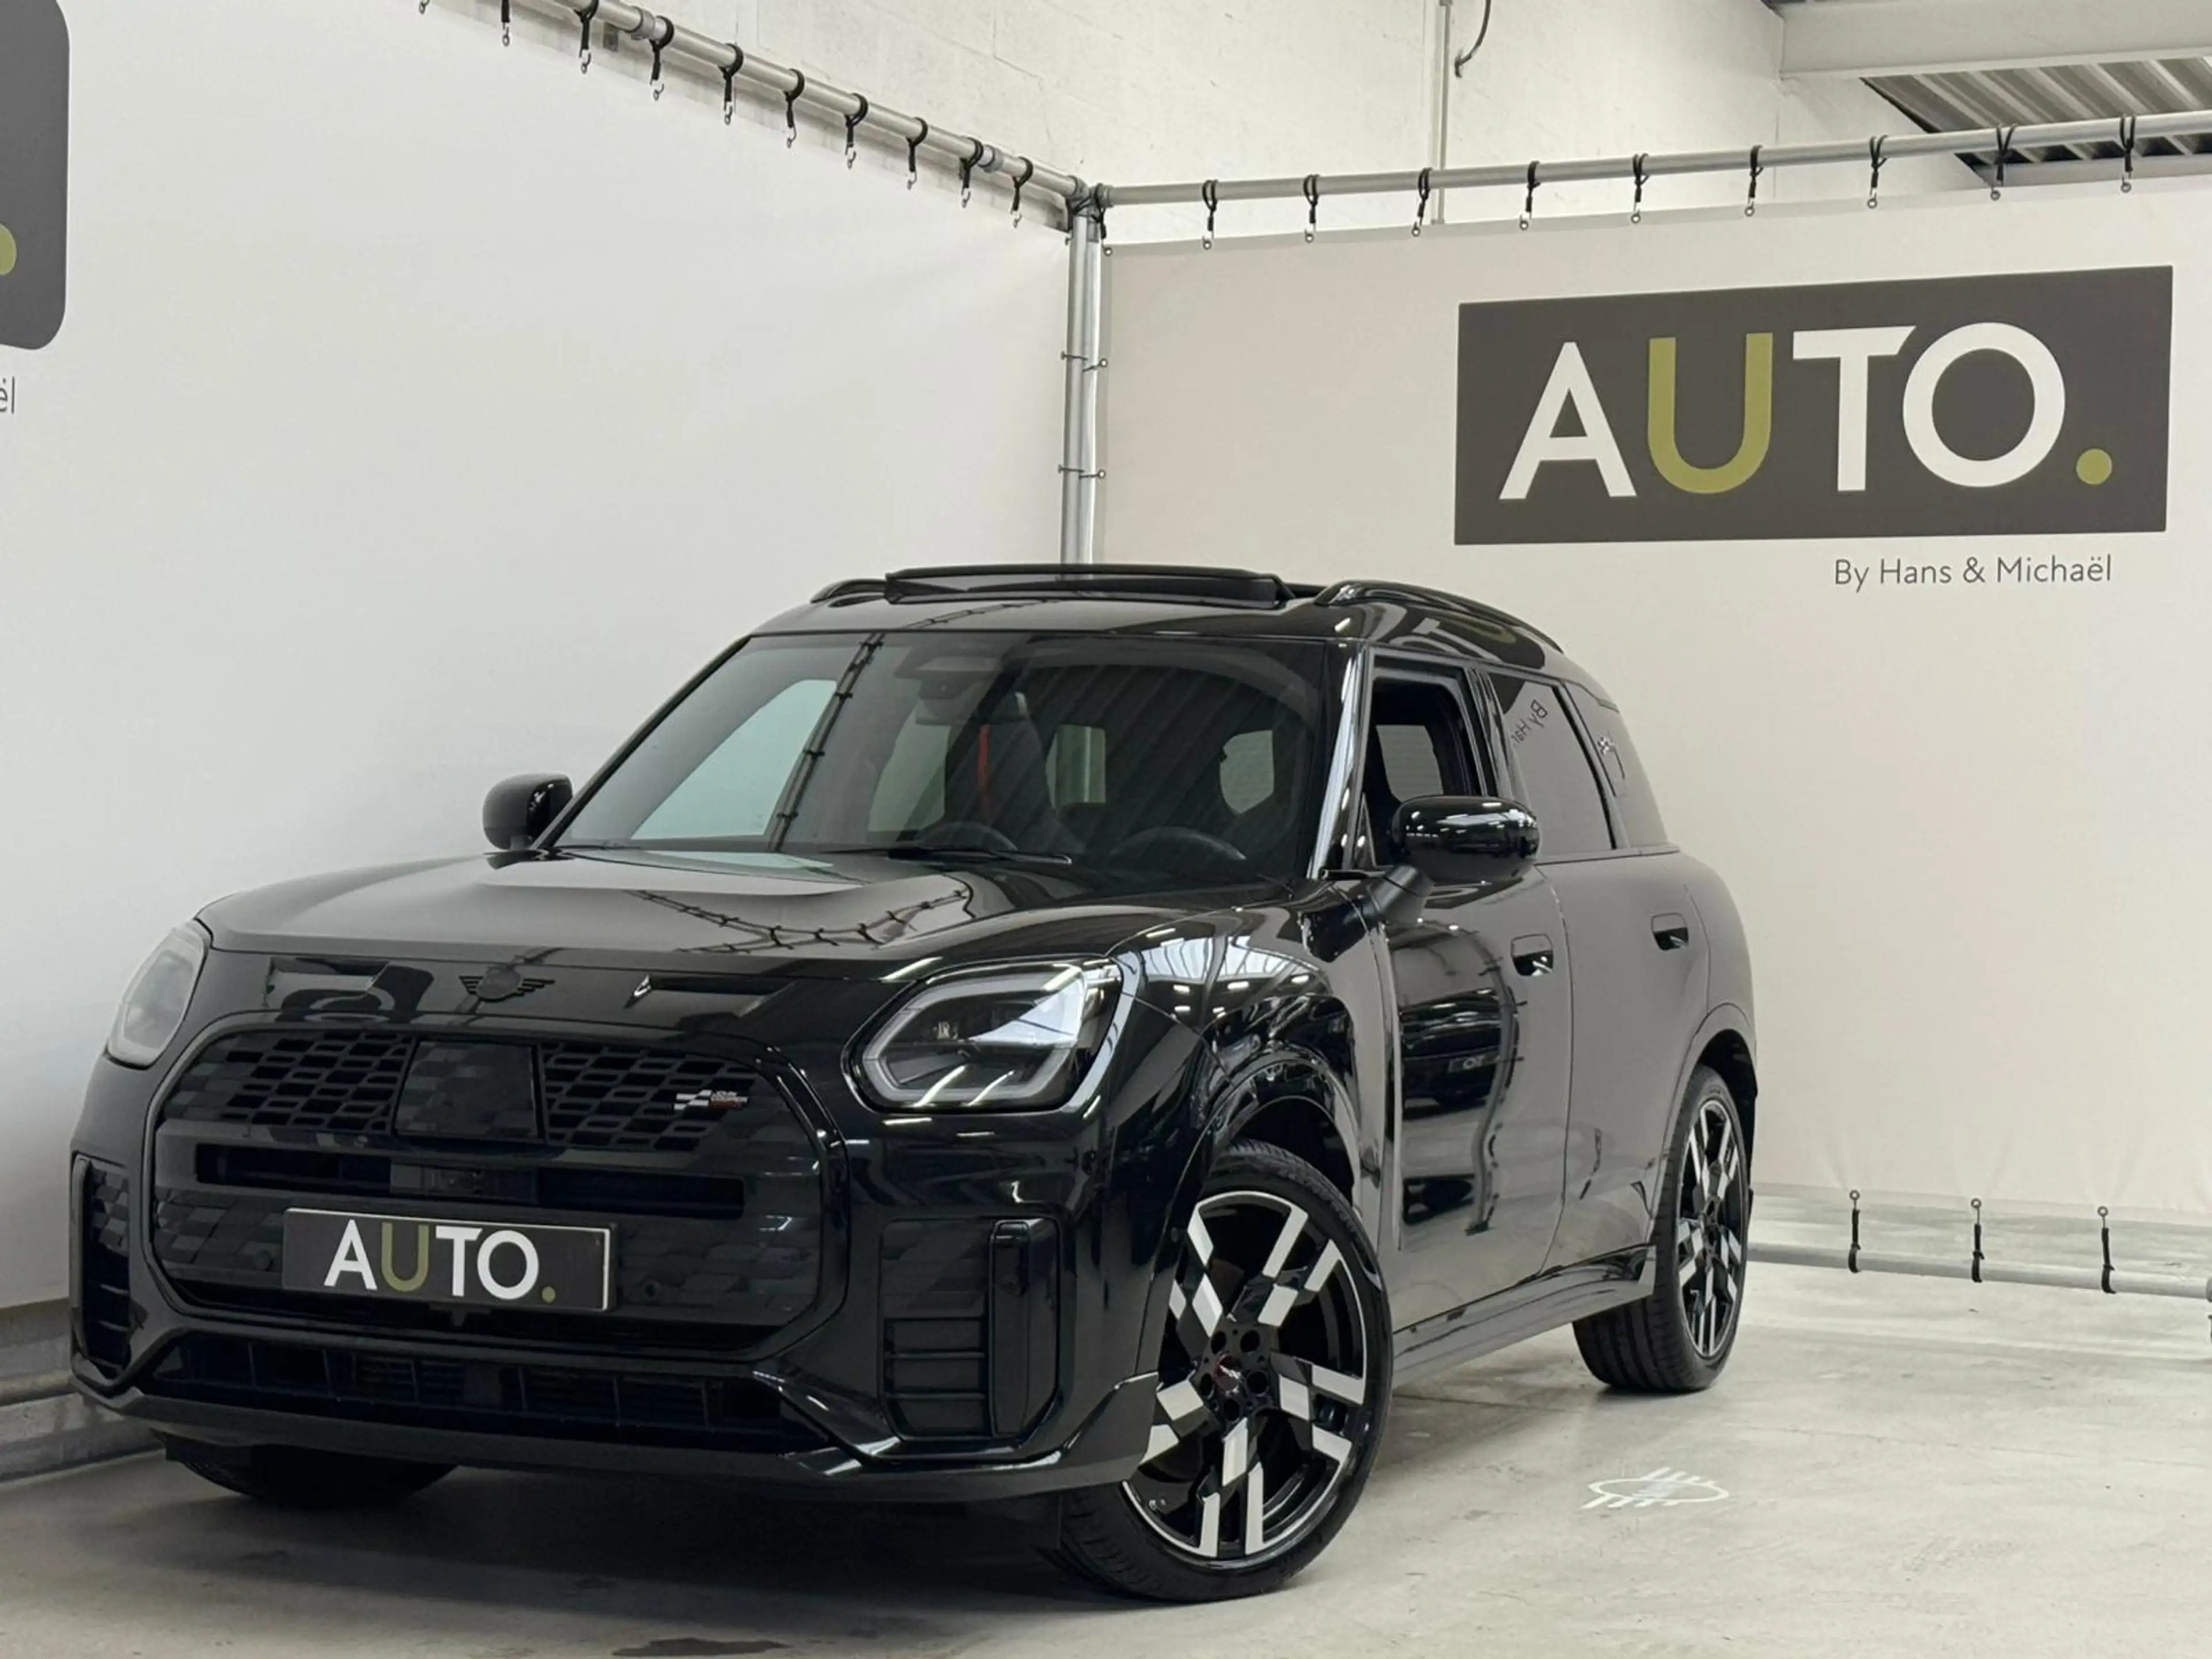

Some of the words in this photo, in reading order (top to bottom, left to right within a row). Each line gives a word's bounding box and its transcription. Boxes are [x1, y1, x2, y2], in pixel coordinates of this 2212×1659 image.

[1498, 321, 2113, 500] AUTO.
[1835, 559, 1869, 593] By
[1880, 558, 1952, 584] Hans
[1963, 556, 1986, 584] &
[1997, 554, 2111, 582] Michaël
[323, 1218, 556, 1301] AUTO.
